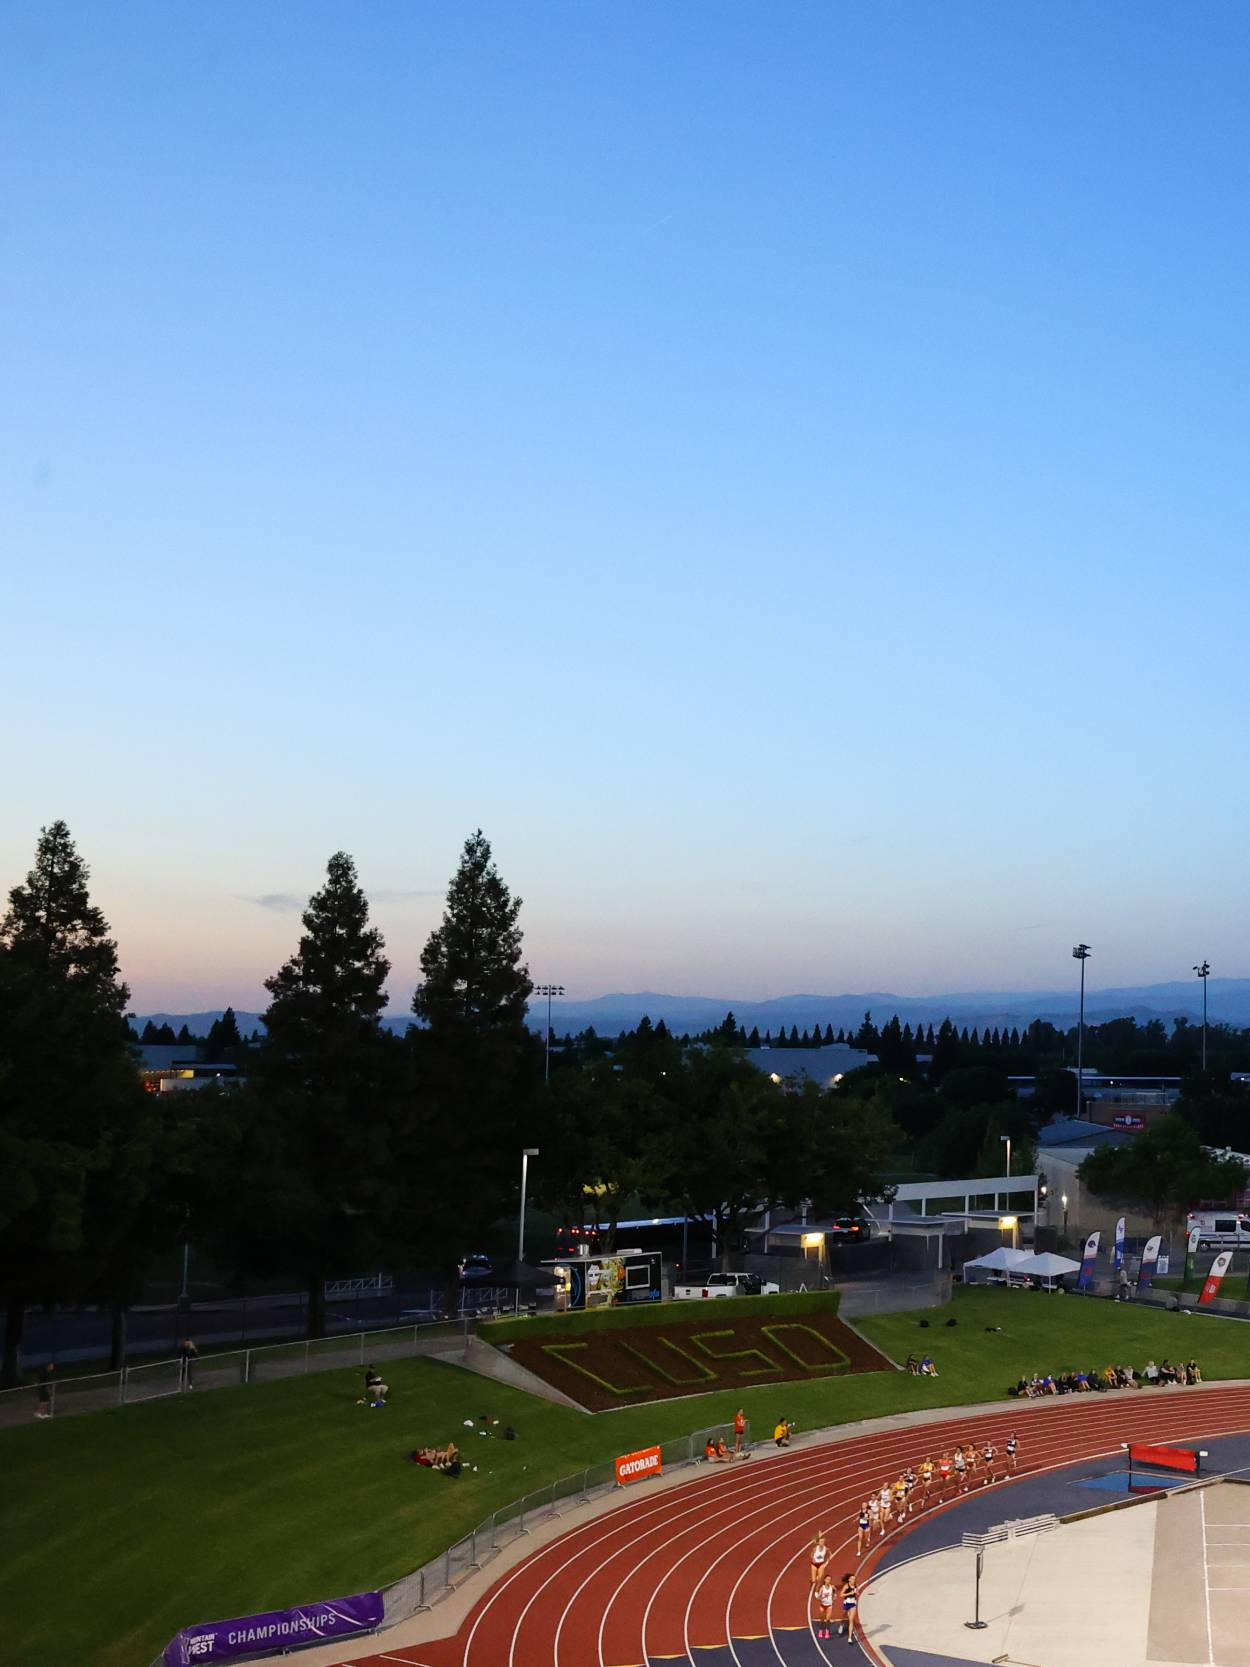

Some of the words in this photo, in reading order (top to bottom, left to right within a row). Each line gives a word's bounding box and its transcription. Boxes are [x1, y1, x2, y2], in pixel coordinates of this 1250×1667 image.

[541, 1324, 851, 1394] CUSD
[619, 1454, 659, 1477] GATORADE
[228, 1612, 336, 1645] CHAMPIONSHIPS
